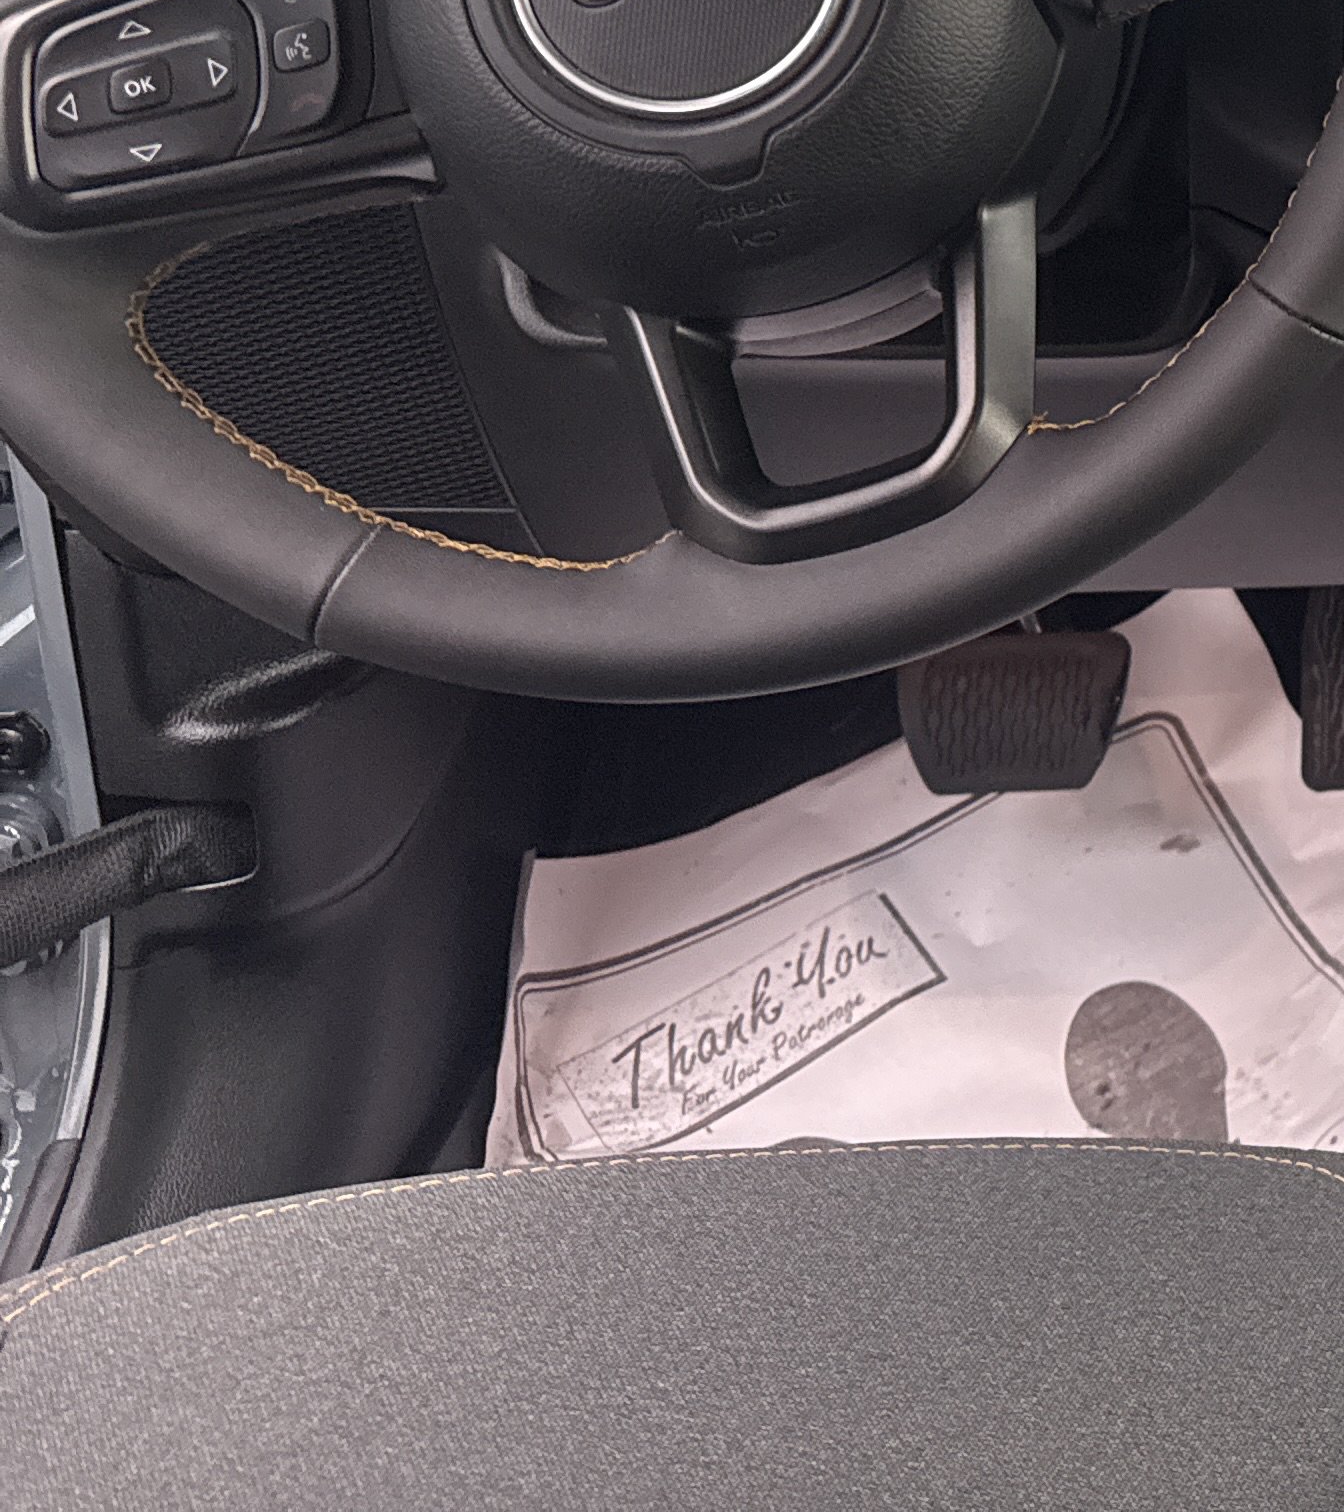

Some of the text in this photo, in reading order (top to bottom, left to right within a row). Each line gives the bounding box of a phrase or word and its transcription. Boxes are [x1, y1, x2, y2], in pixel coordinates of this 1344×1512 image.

[123, 75, 156, 98] OK
[611, 925, 889, 1110] Thank You
[681, 1085, 715, 1116] For
[722, 1056, 765, 1090] Your
